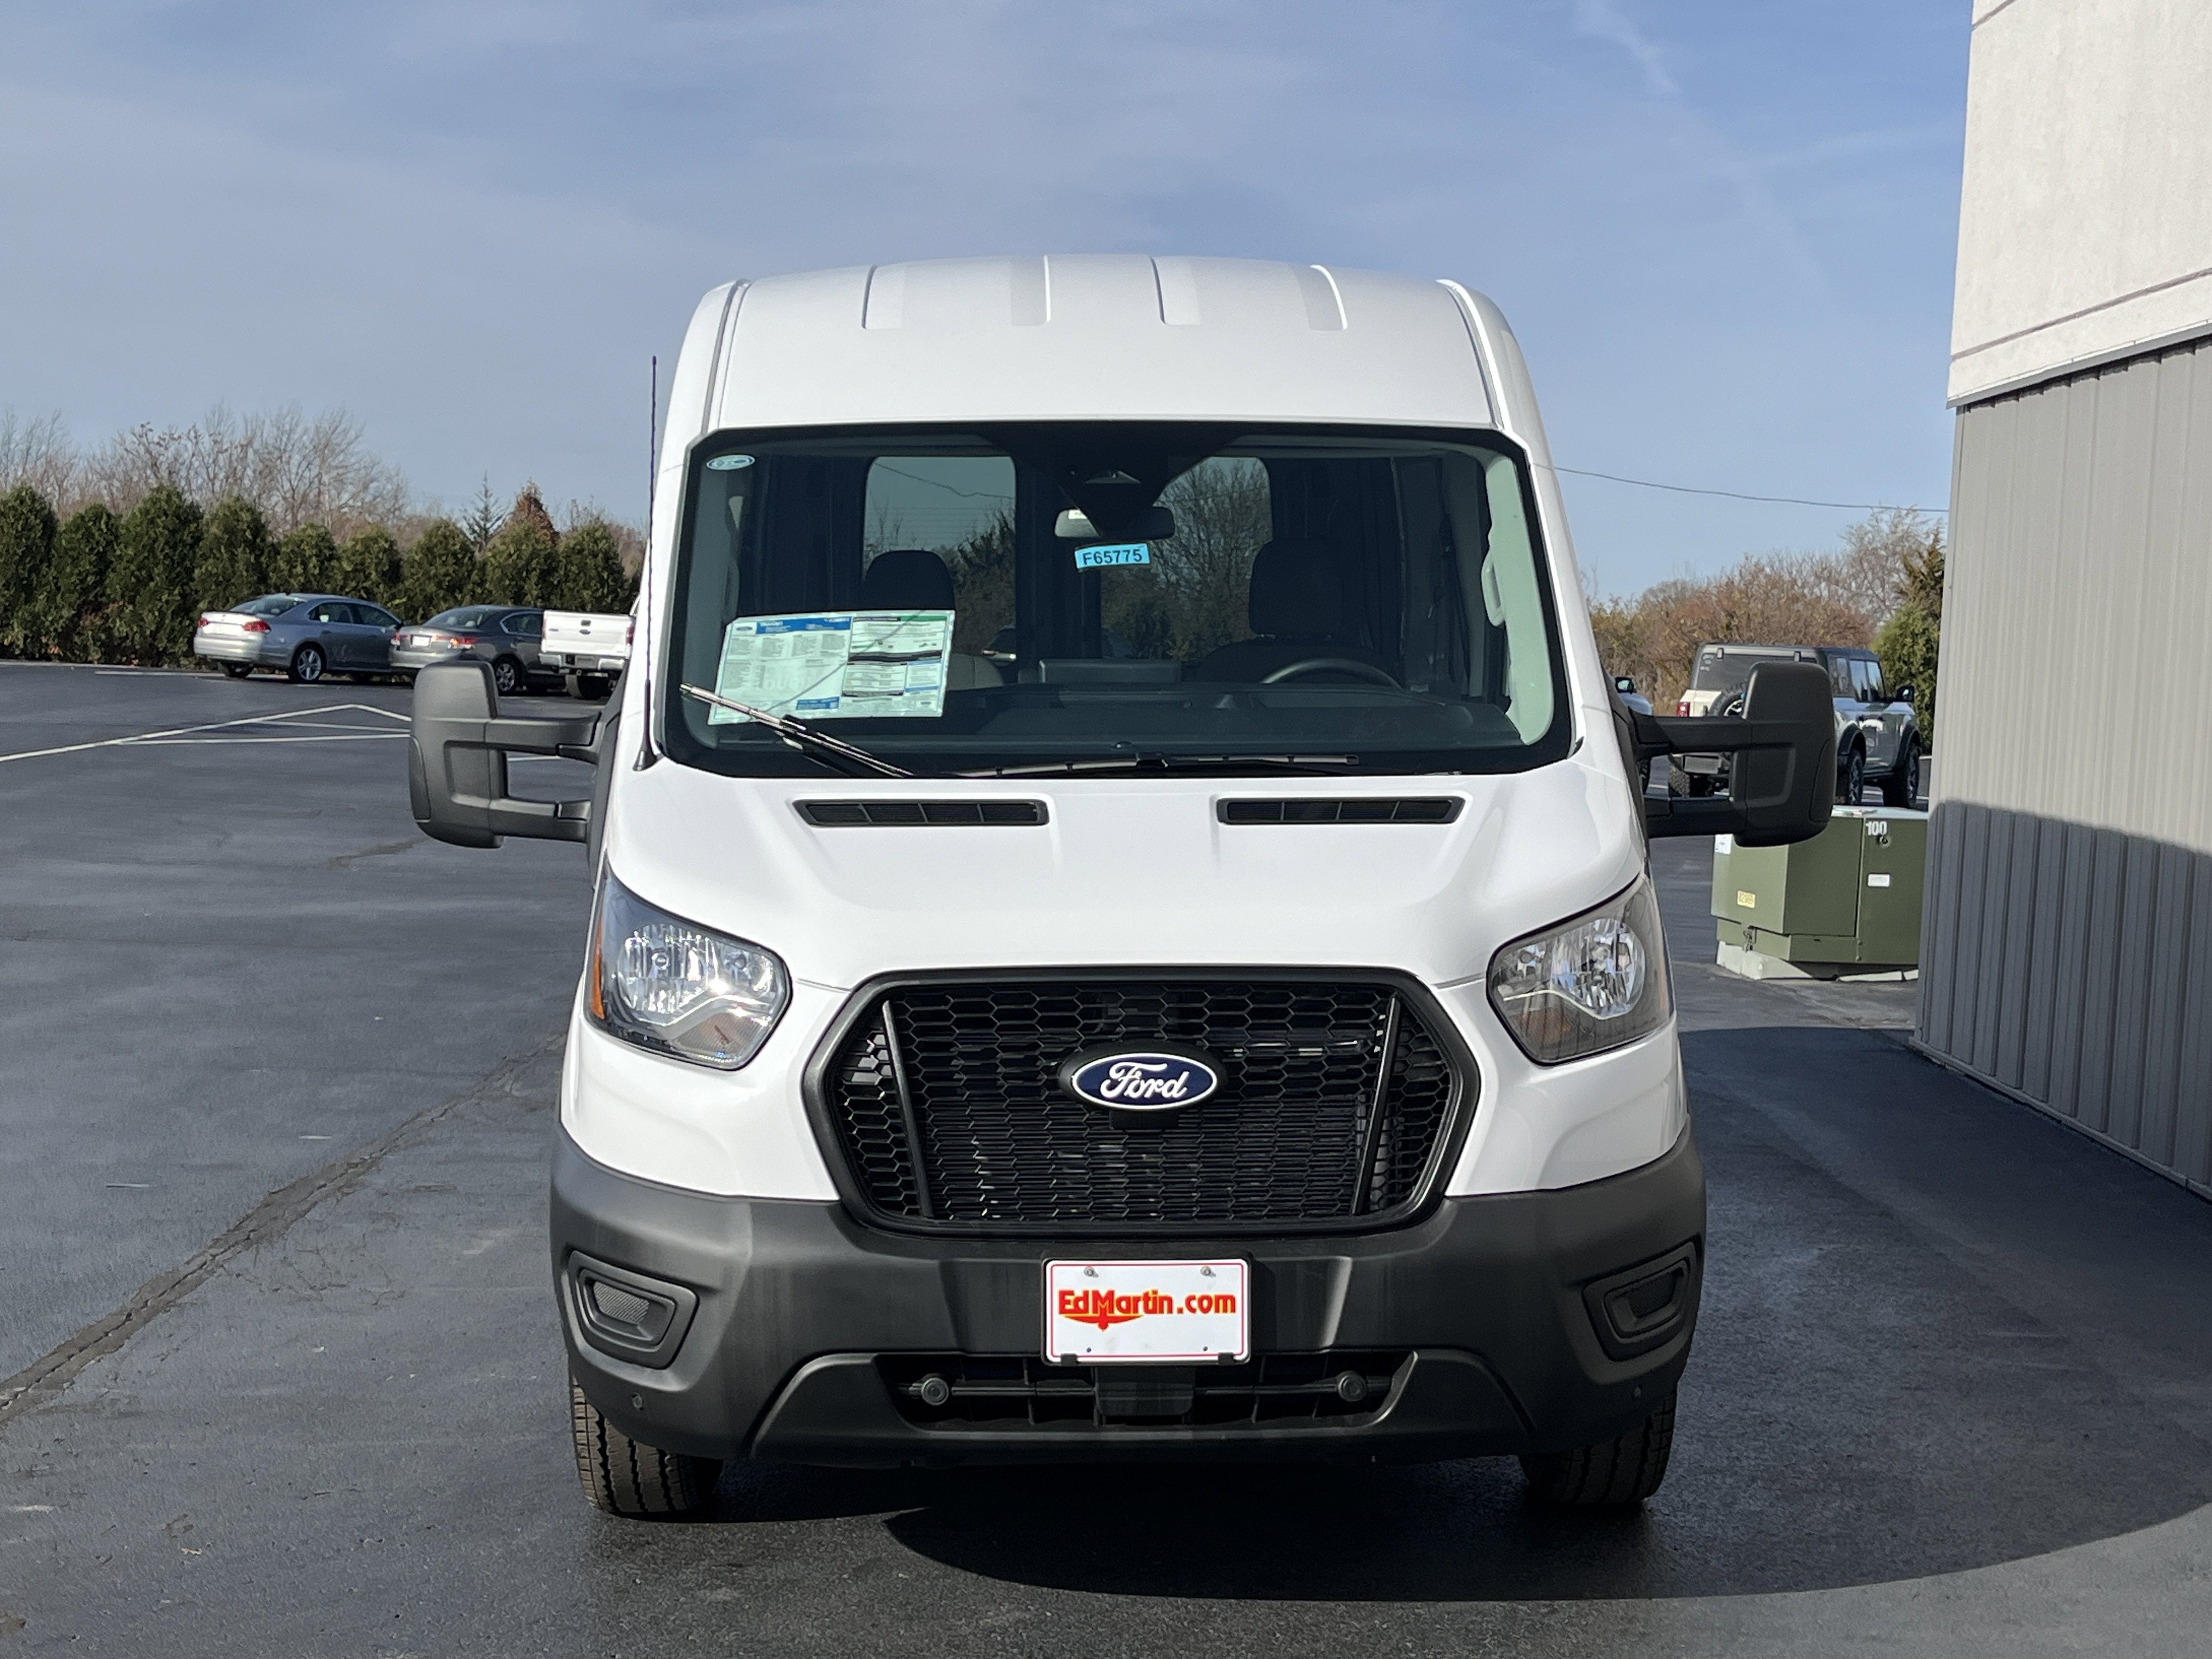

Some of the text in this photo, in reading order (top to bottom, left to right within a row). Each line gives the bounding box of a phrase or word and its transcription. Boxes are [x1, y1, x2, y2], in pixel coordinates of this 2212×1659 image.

[1082, 549, 1142, 565] F65775
[1865, 821, 1887, 836] 100
[1100, 1062, 1190, 1098] Ford
[1058, 1289, 1236, 1315] EdMartin.com
